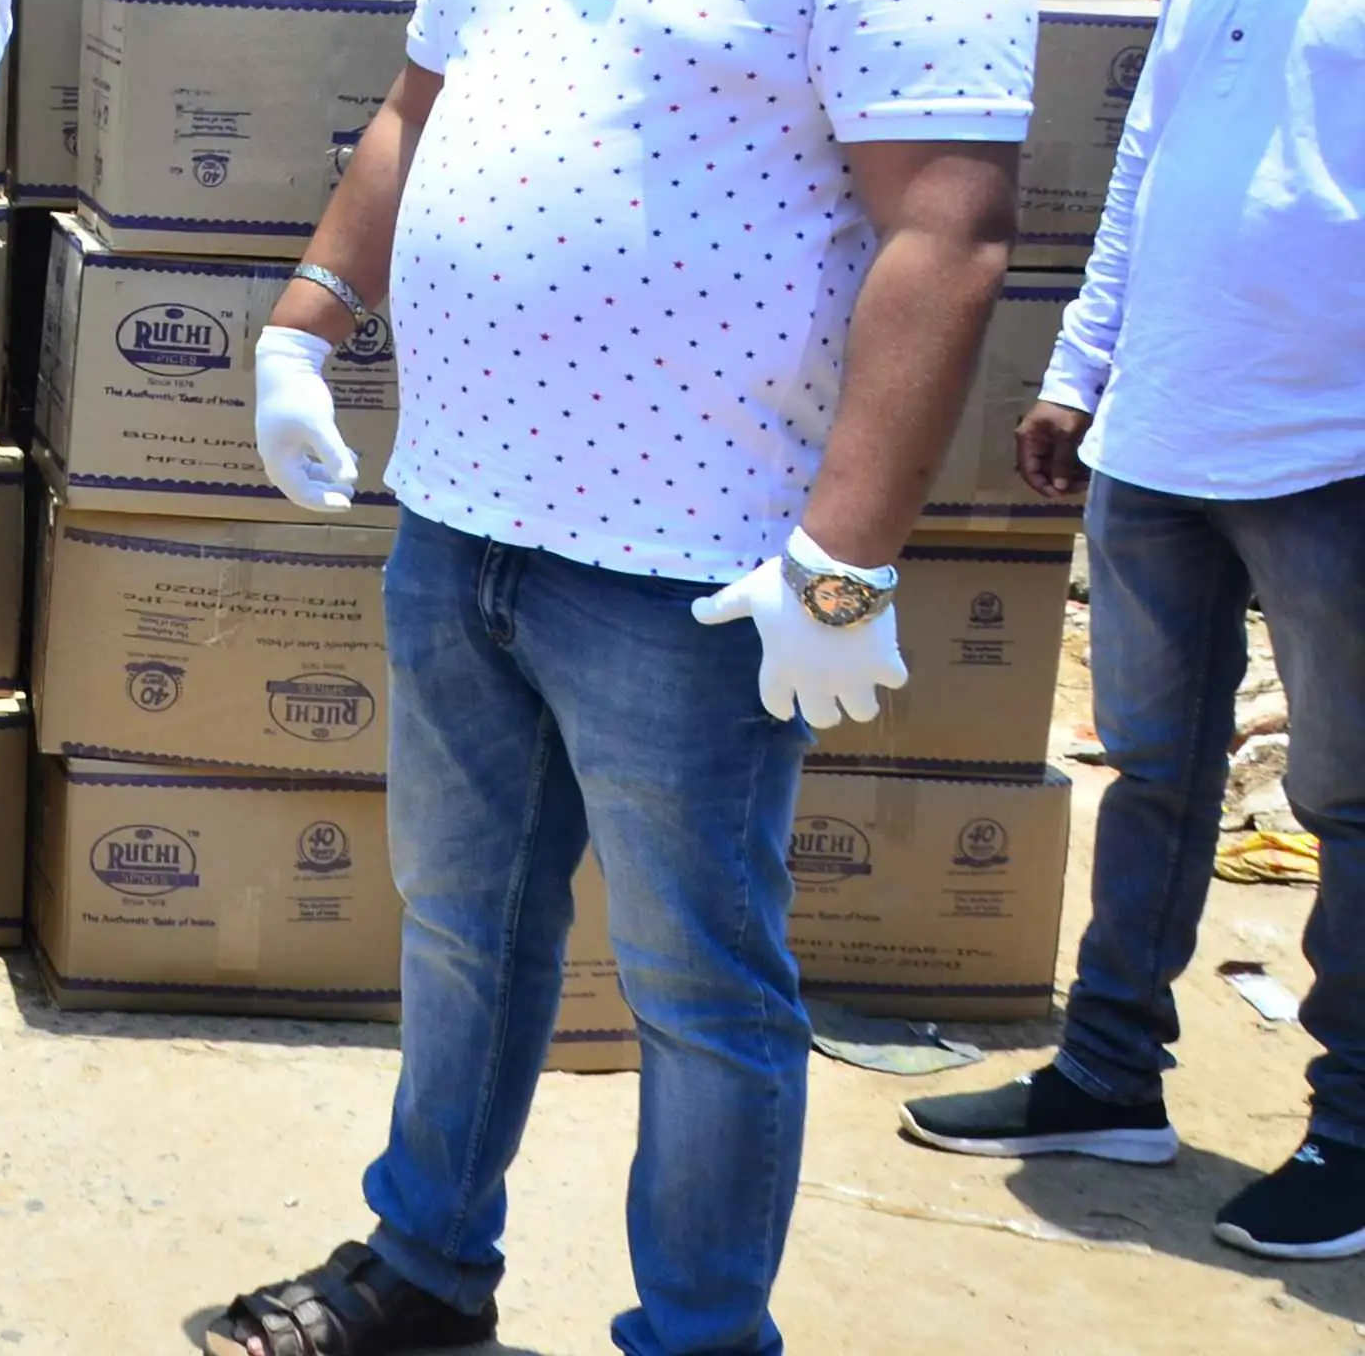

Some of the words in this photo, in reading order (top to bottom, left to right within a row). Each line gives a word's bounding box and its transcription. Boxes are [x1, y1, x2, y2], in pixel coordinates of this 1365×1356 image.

[203, 171, 221, 184] 40
[134, 321, 212, 353] RUCHI
[149, 354, 198, 368] SPICES
[104, 386, 123, 398] The
[125, 387, 175, 402] Authentic
[123, 430, 197, 441] BOHU
[140, 687, 170, 706] 40
[285, 697, 359, 725] RUCHI
[308, 827, 335, 846] 40
[967, 824, 995, 842] 40
[107, 842, 180, 871] RUCHI
[82, 913, 100, 922] The
